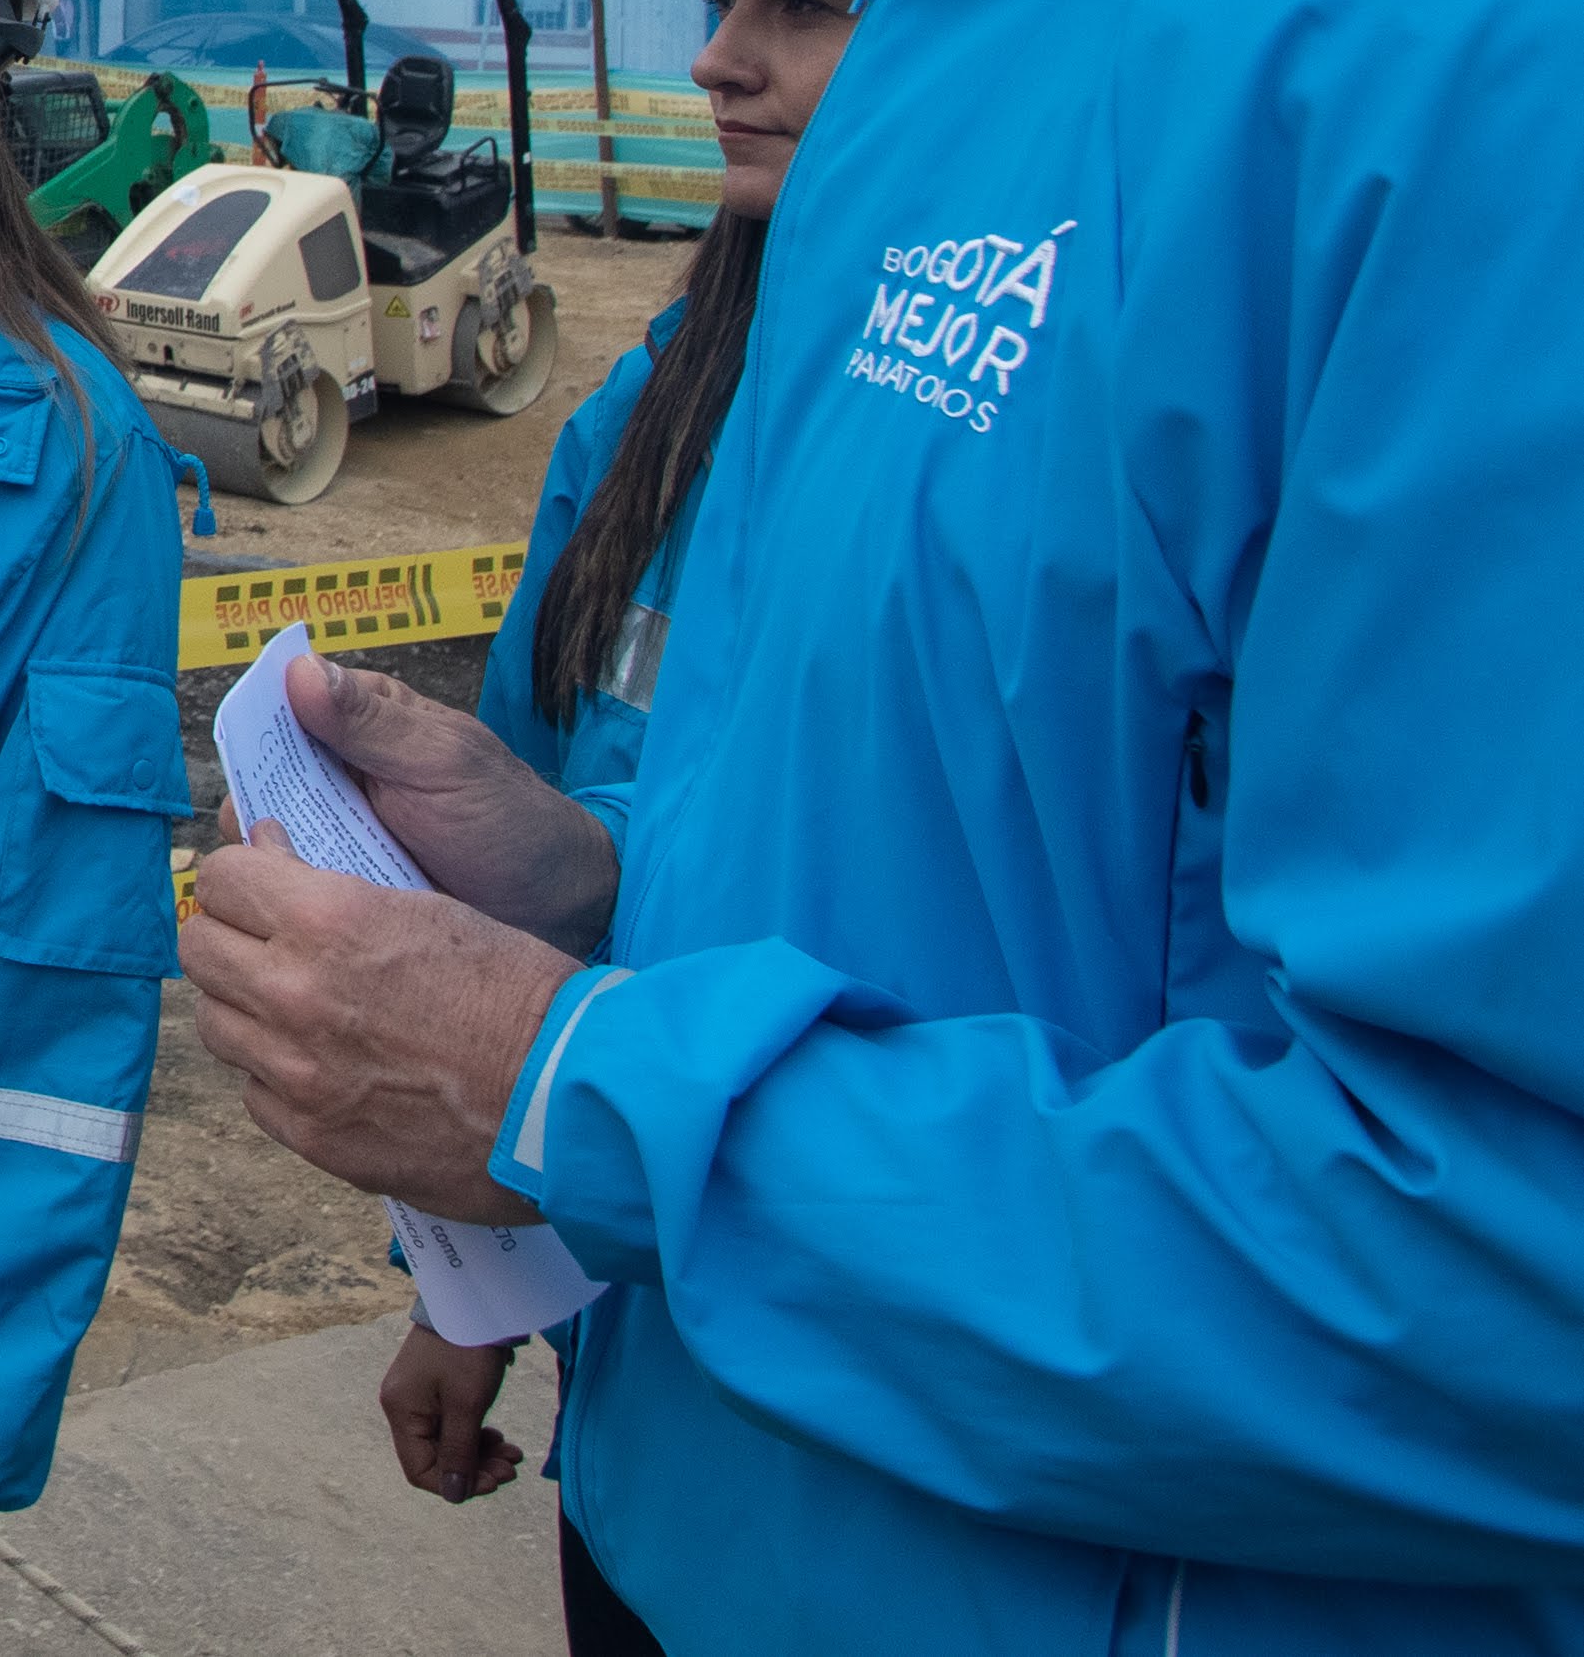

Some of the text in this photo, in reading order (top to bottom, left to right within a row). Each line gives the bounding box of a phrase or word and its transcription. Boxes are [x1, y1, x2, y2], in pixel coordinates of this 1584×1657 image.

[882, 219, 1078, 329] BOGOTÁ
[125, 298, 221, 333] Ingersoll-Rand
[862, 283, 1029, 396] MEJOR
[279, 704, 308, 774] Estamos
[273, 713, 330, 821] alcantarillado
[301, 797, 333, 838] parte
[349, 806, 365, 826] de
[396, 1198, 425, 1250] ervicio
[430, 1224, 464, 1269] como
